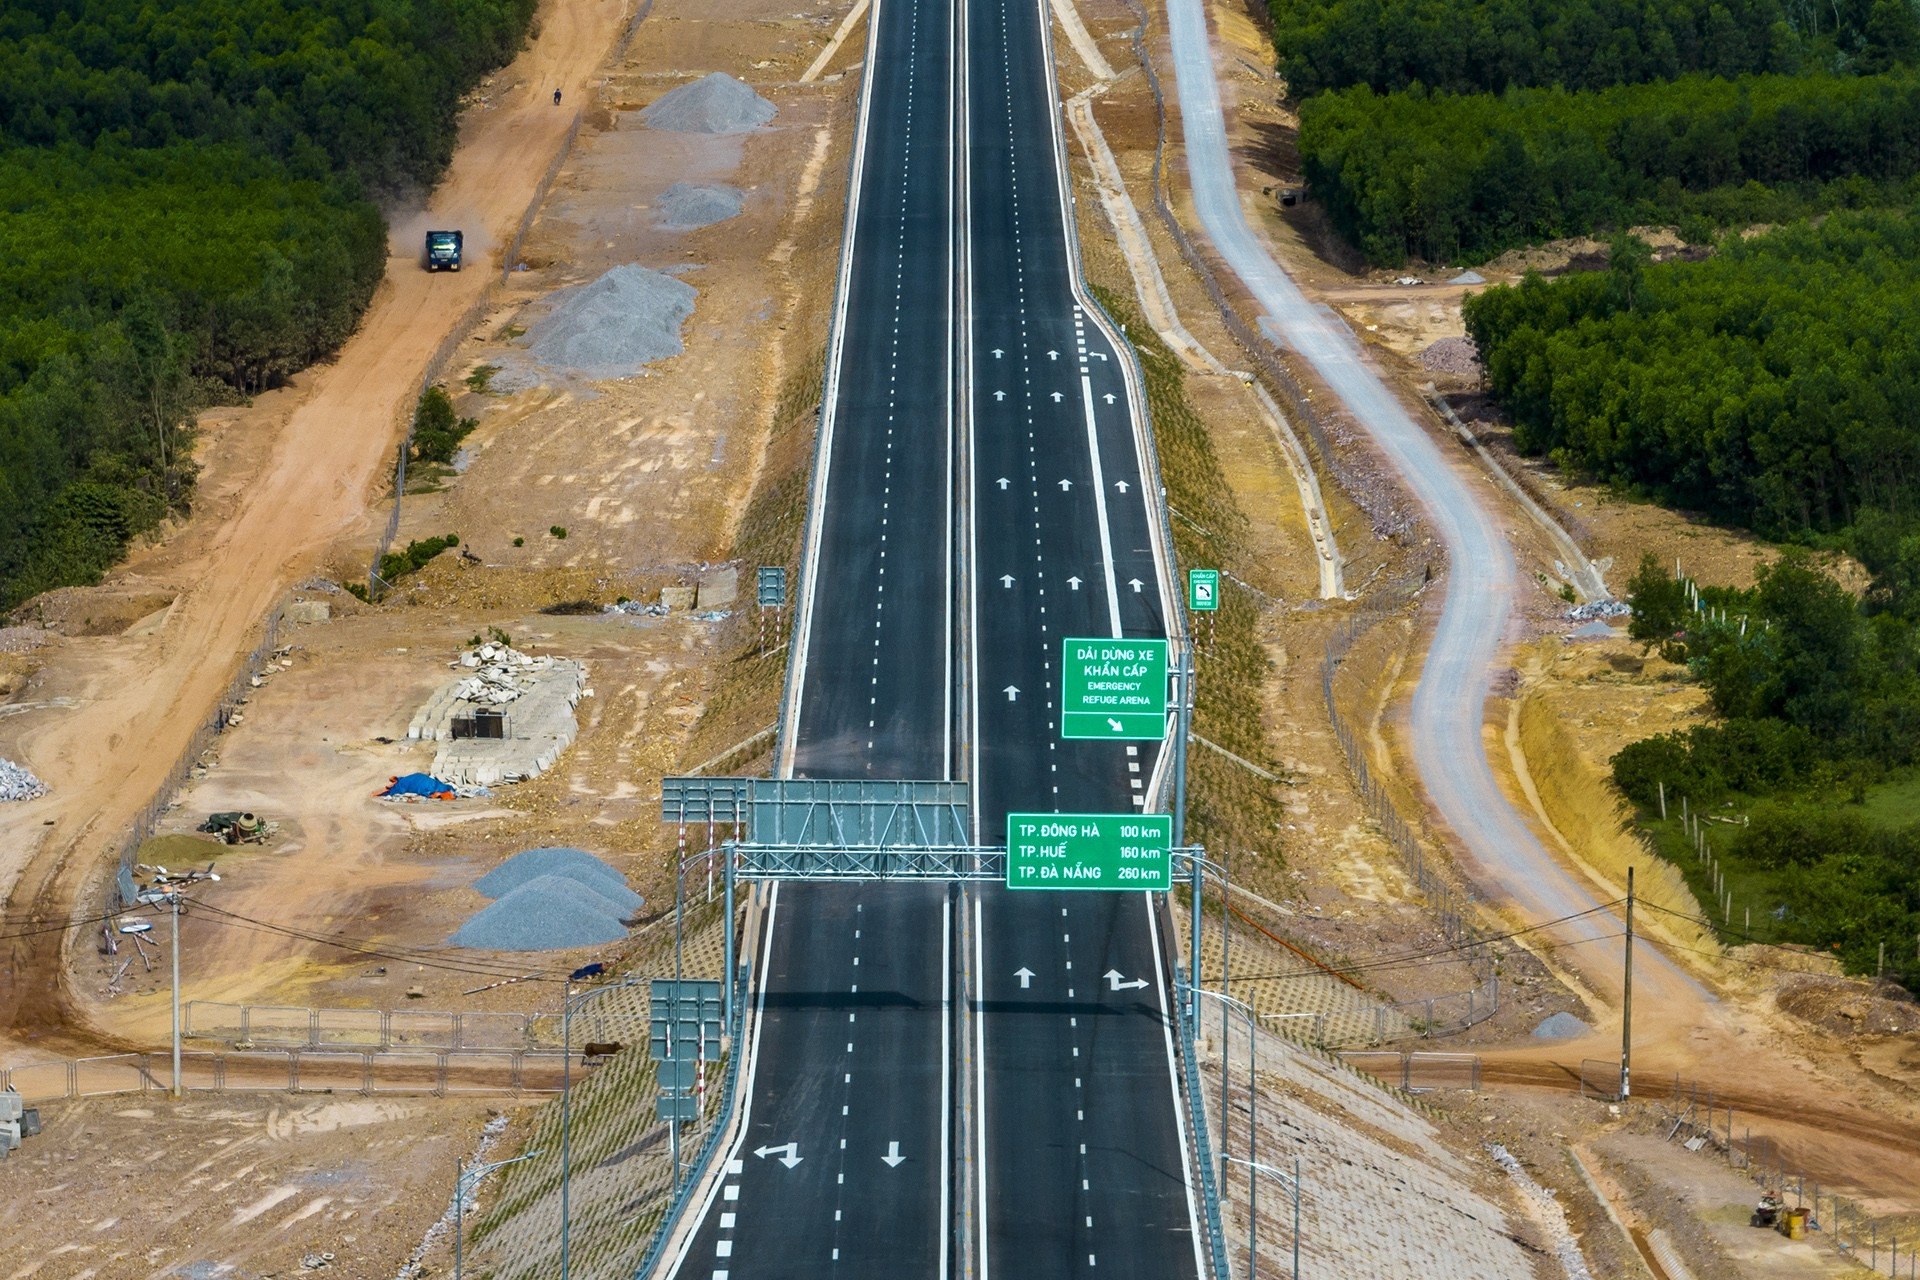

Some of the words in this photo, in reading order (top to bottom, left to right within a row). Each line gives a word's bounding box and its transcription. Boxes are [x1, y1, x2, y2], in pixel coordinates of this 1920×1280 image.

[1078, 646, 1097, 659] DẢI
[1139, 650, 1153, 660] XE
[1084, 661, 1119, 676] KHẨN
[1123, 663, 1147, 676] CẤP
[1088, 682, 1141, 690] EMERGENCY
[1083, 696, 1117, 704] REFUGE
[1120, 696, 1150, 704] ARENA
[1082, 823, 1100, 836] HÀ
[1120, 826, 1138, 837] 100
[1142, 826, 1160, 837] km
[1120, 847, 1138, 858] 160
[1141, 847, 1160, 858] km
[1064, 862, 1101, 878] NẴNG
[1118, 867, 1139, 879] 260
[1141, 868, 1160, 879] km
